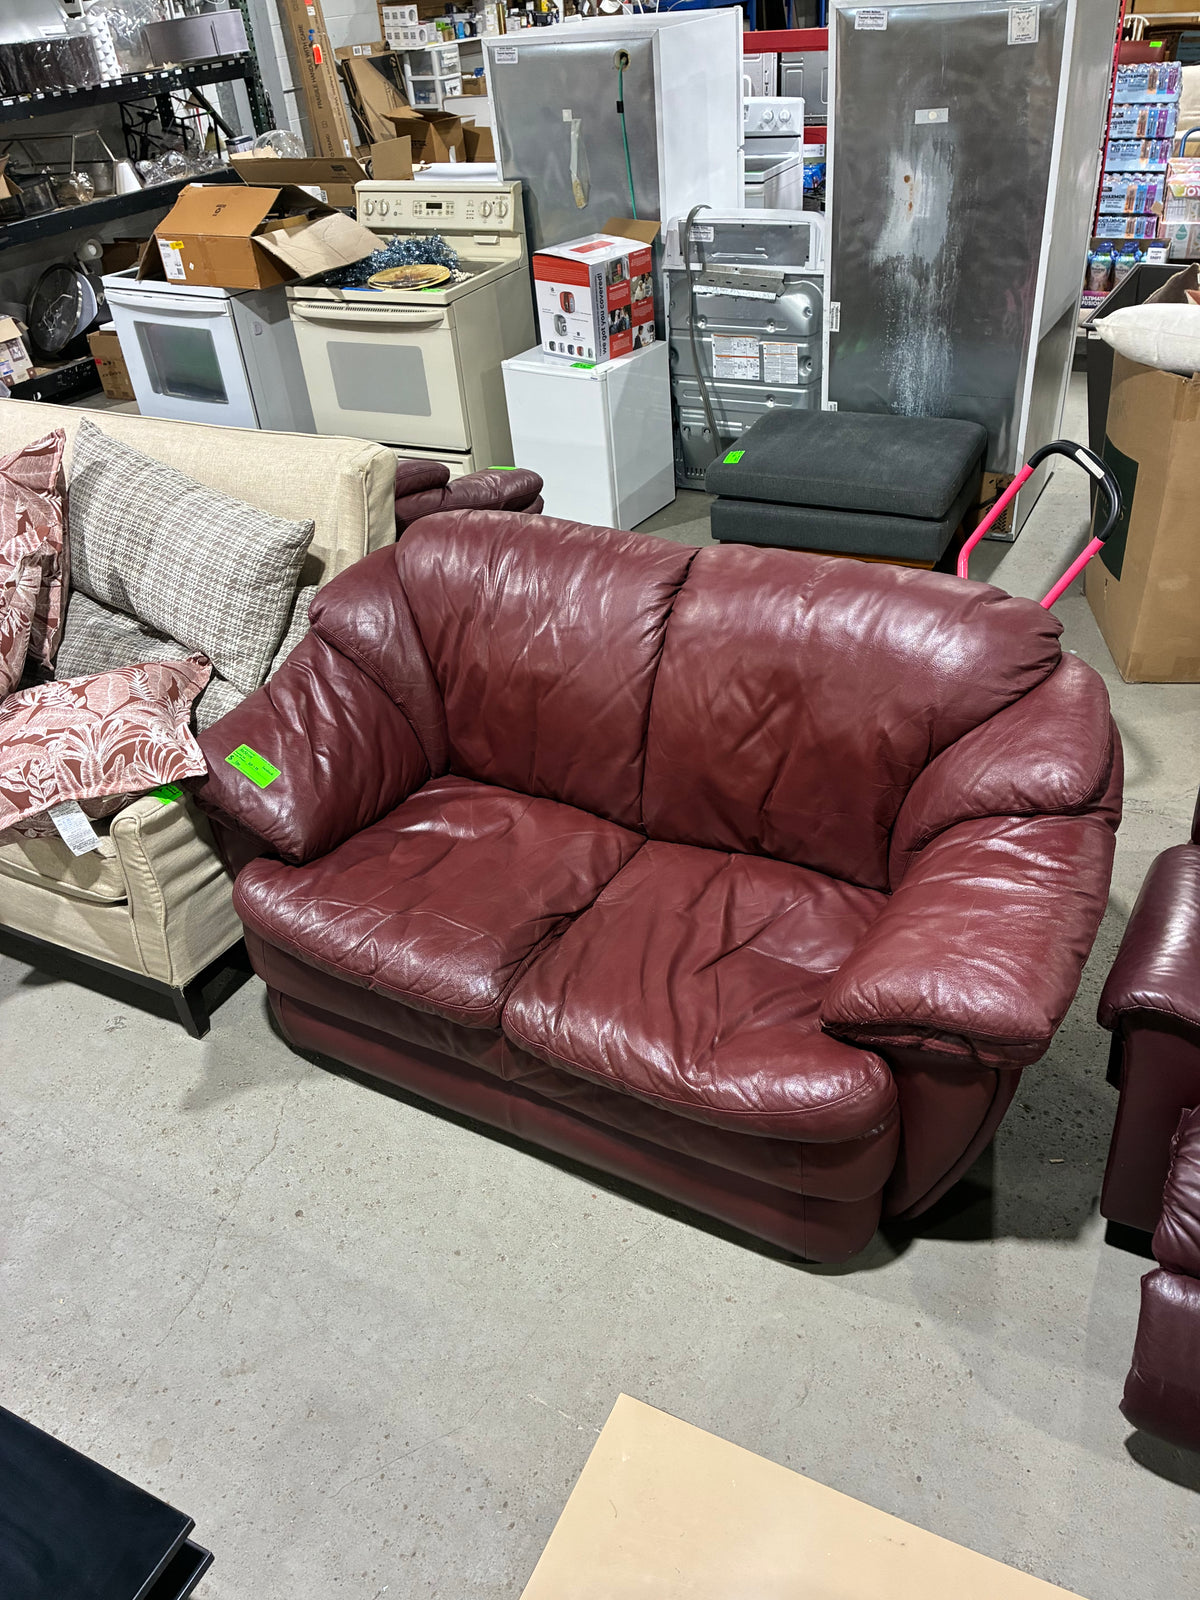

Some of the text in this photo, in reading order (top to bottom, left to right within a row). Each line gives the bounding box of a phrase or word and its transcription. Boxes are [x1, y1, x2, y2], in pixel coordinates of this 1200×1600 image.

[298, 24, 323, 109] FRAGILE HANDLE WITH CARE
[602, 342, 607, 355] we
